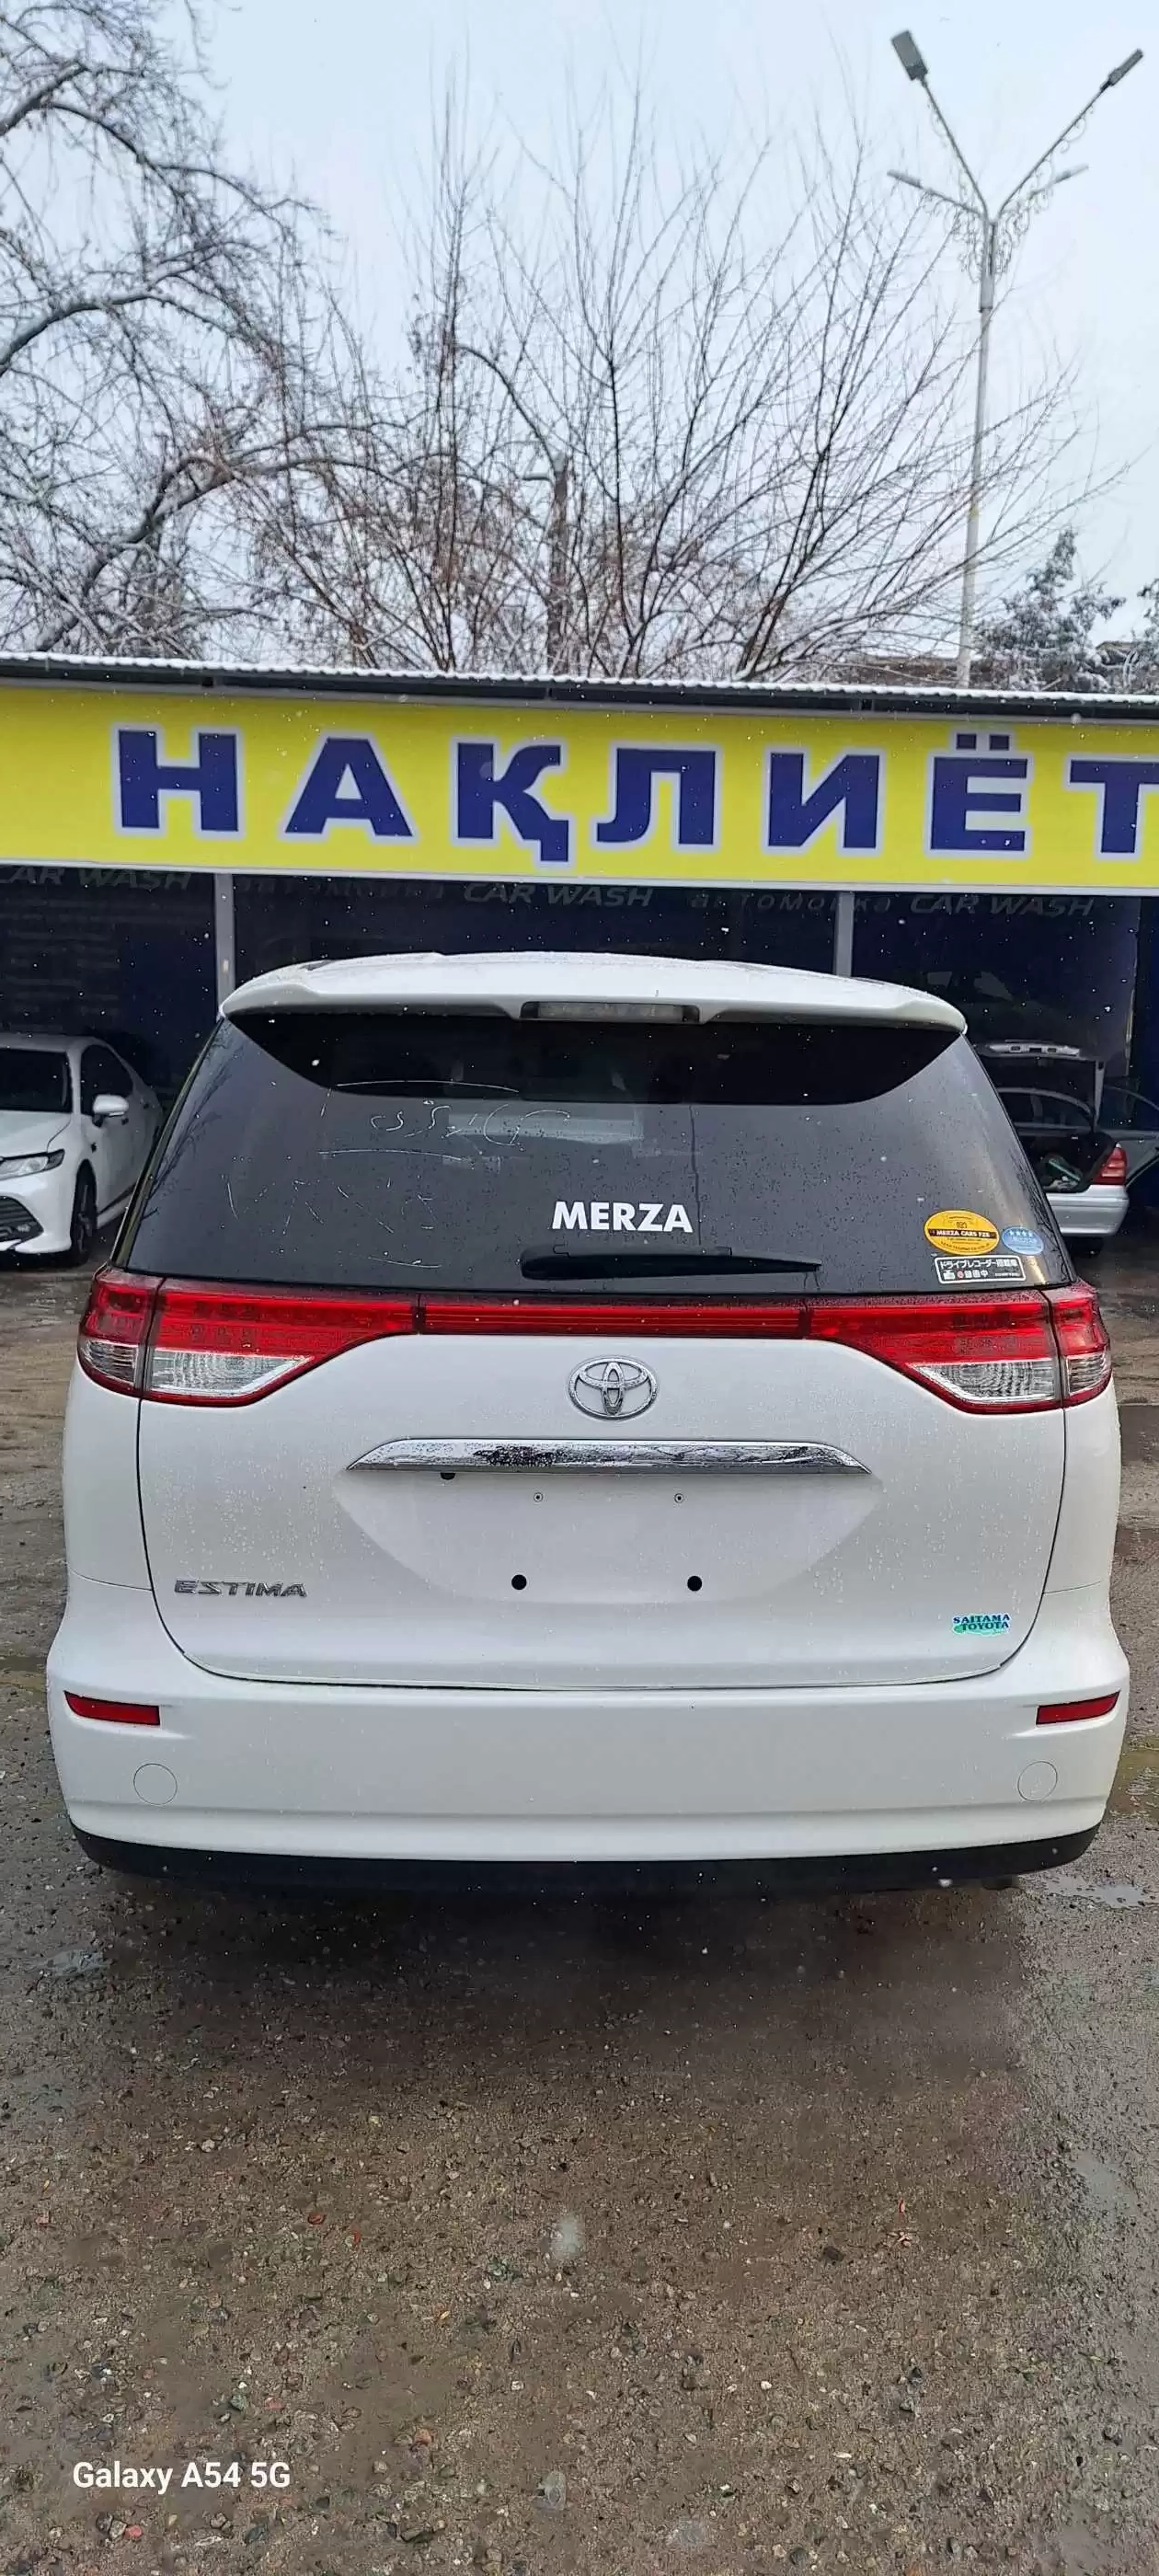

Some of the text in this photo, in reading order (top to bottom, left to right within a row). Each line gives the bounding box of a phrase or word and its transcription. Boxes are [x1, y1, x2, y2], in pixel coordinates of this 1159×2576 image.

[116, 728, 1159, 863] НАҚЛИЁТ
[0, 868, 65, 886] AR
[464, 883, 535, 903] CAR
[547, 884, 653, 907] WASH
[911, 894, 1095, 917] CAR WASH
[552, 1201, 694, 1233] MERZA
[175, 1579, 307, 1597] ESTIMA
[953, 1614, 1010, 1624] SAITAMA
[962, 1621, 1009, 1631] TOYOTA
